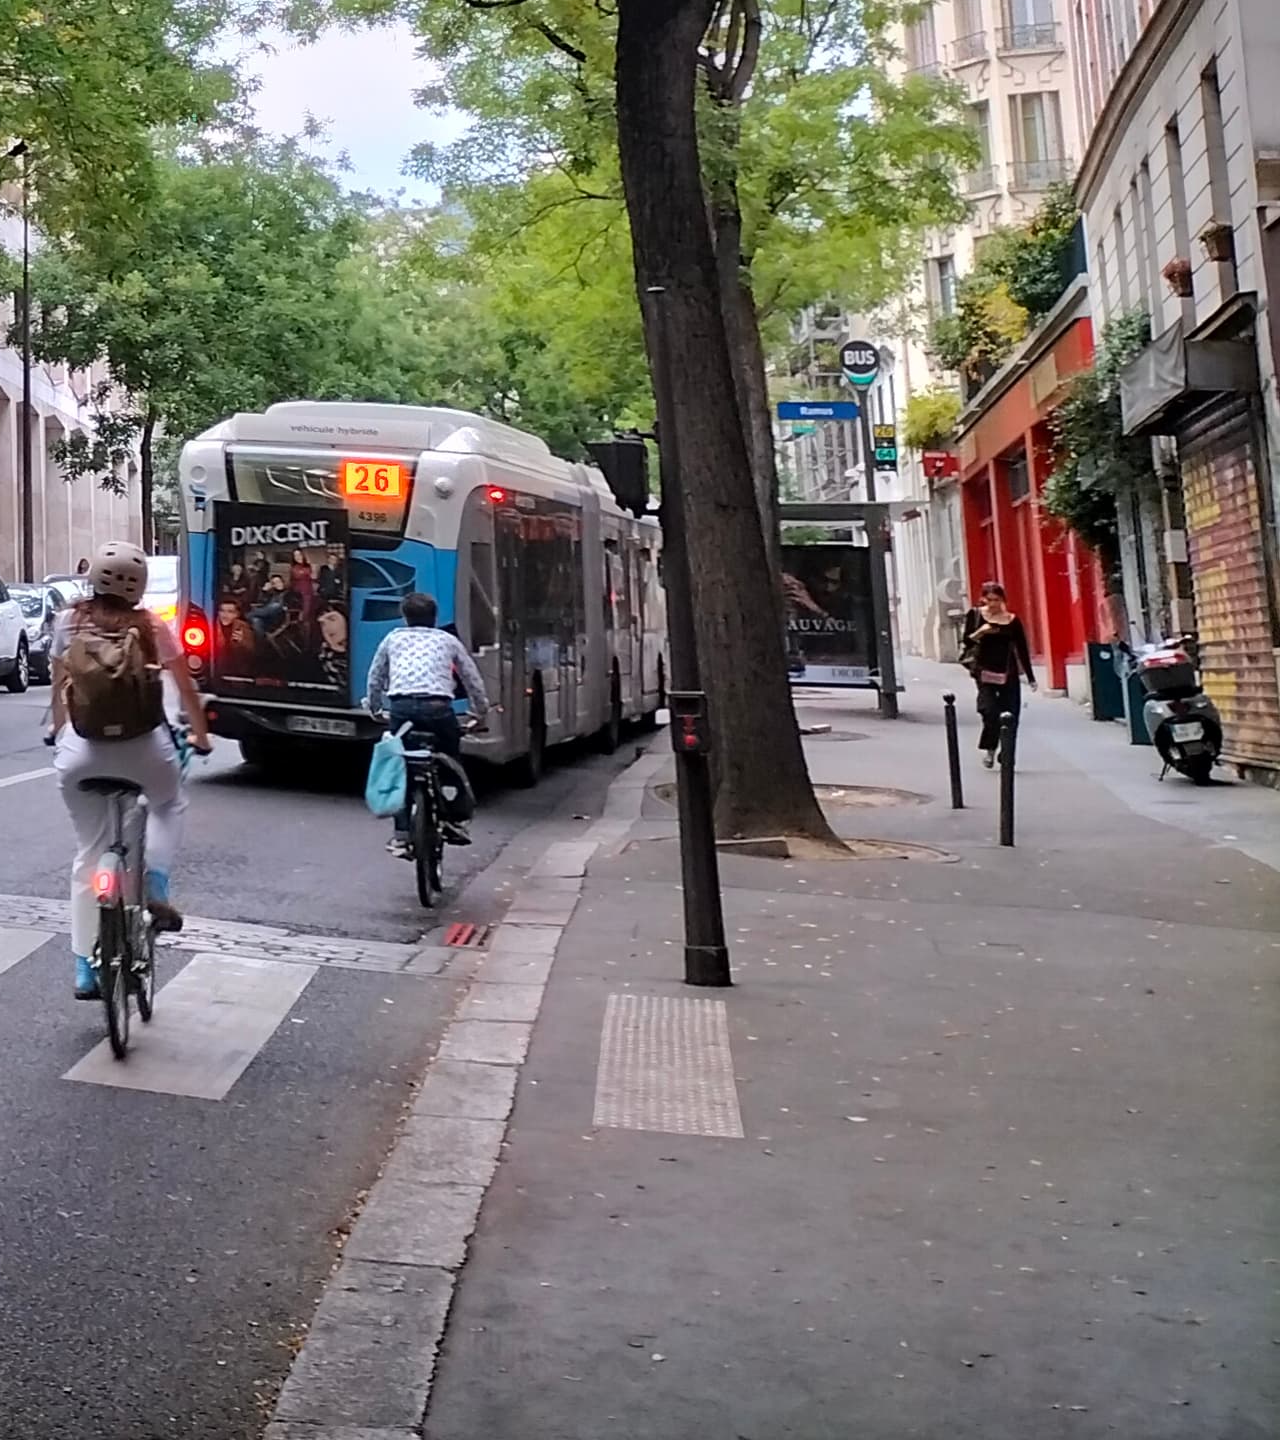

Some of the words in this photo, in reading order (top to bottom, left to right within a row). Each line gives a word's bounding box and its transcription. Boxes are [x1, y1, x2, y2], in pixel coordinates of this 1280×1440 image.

[843, 350, 875, 365] BUS
[338, 427, 379, 436] hybride
[354, 466, 389, 491] 26
[272, 520, 330, 543] CENT
[787, 619, 857, 633] AUVAGE
